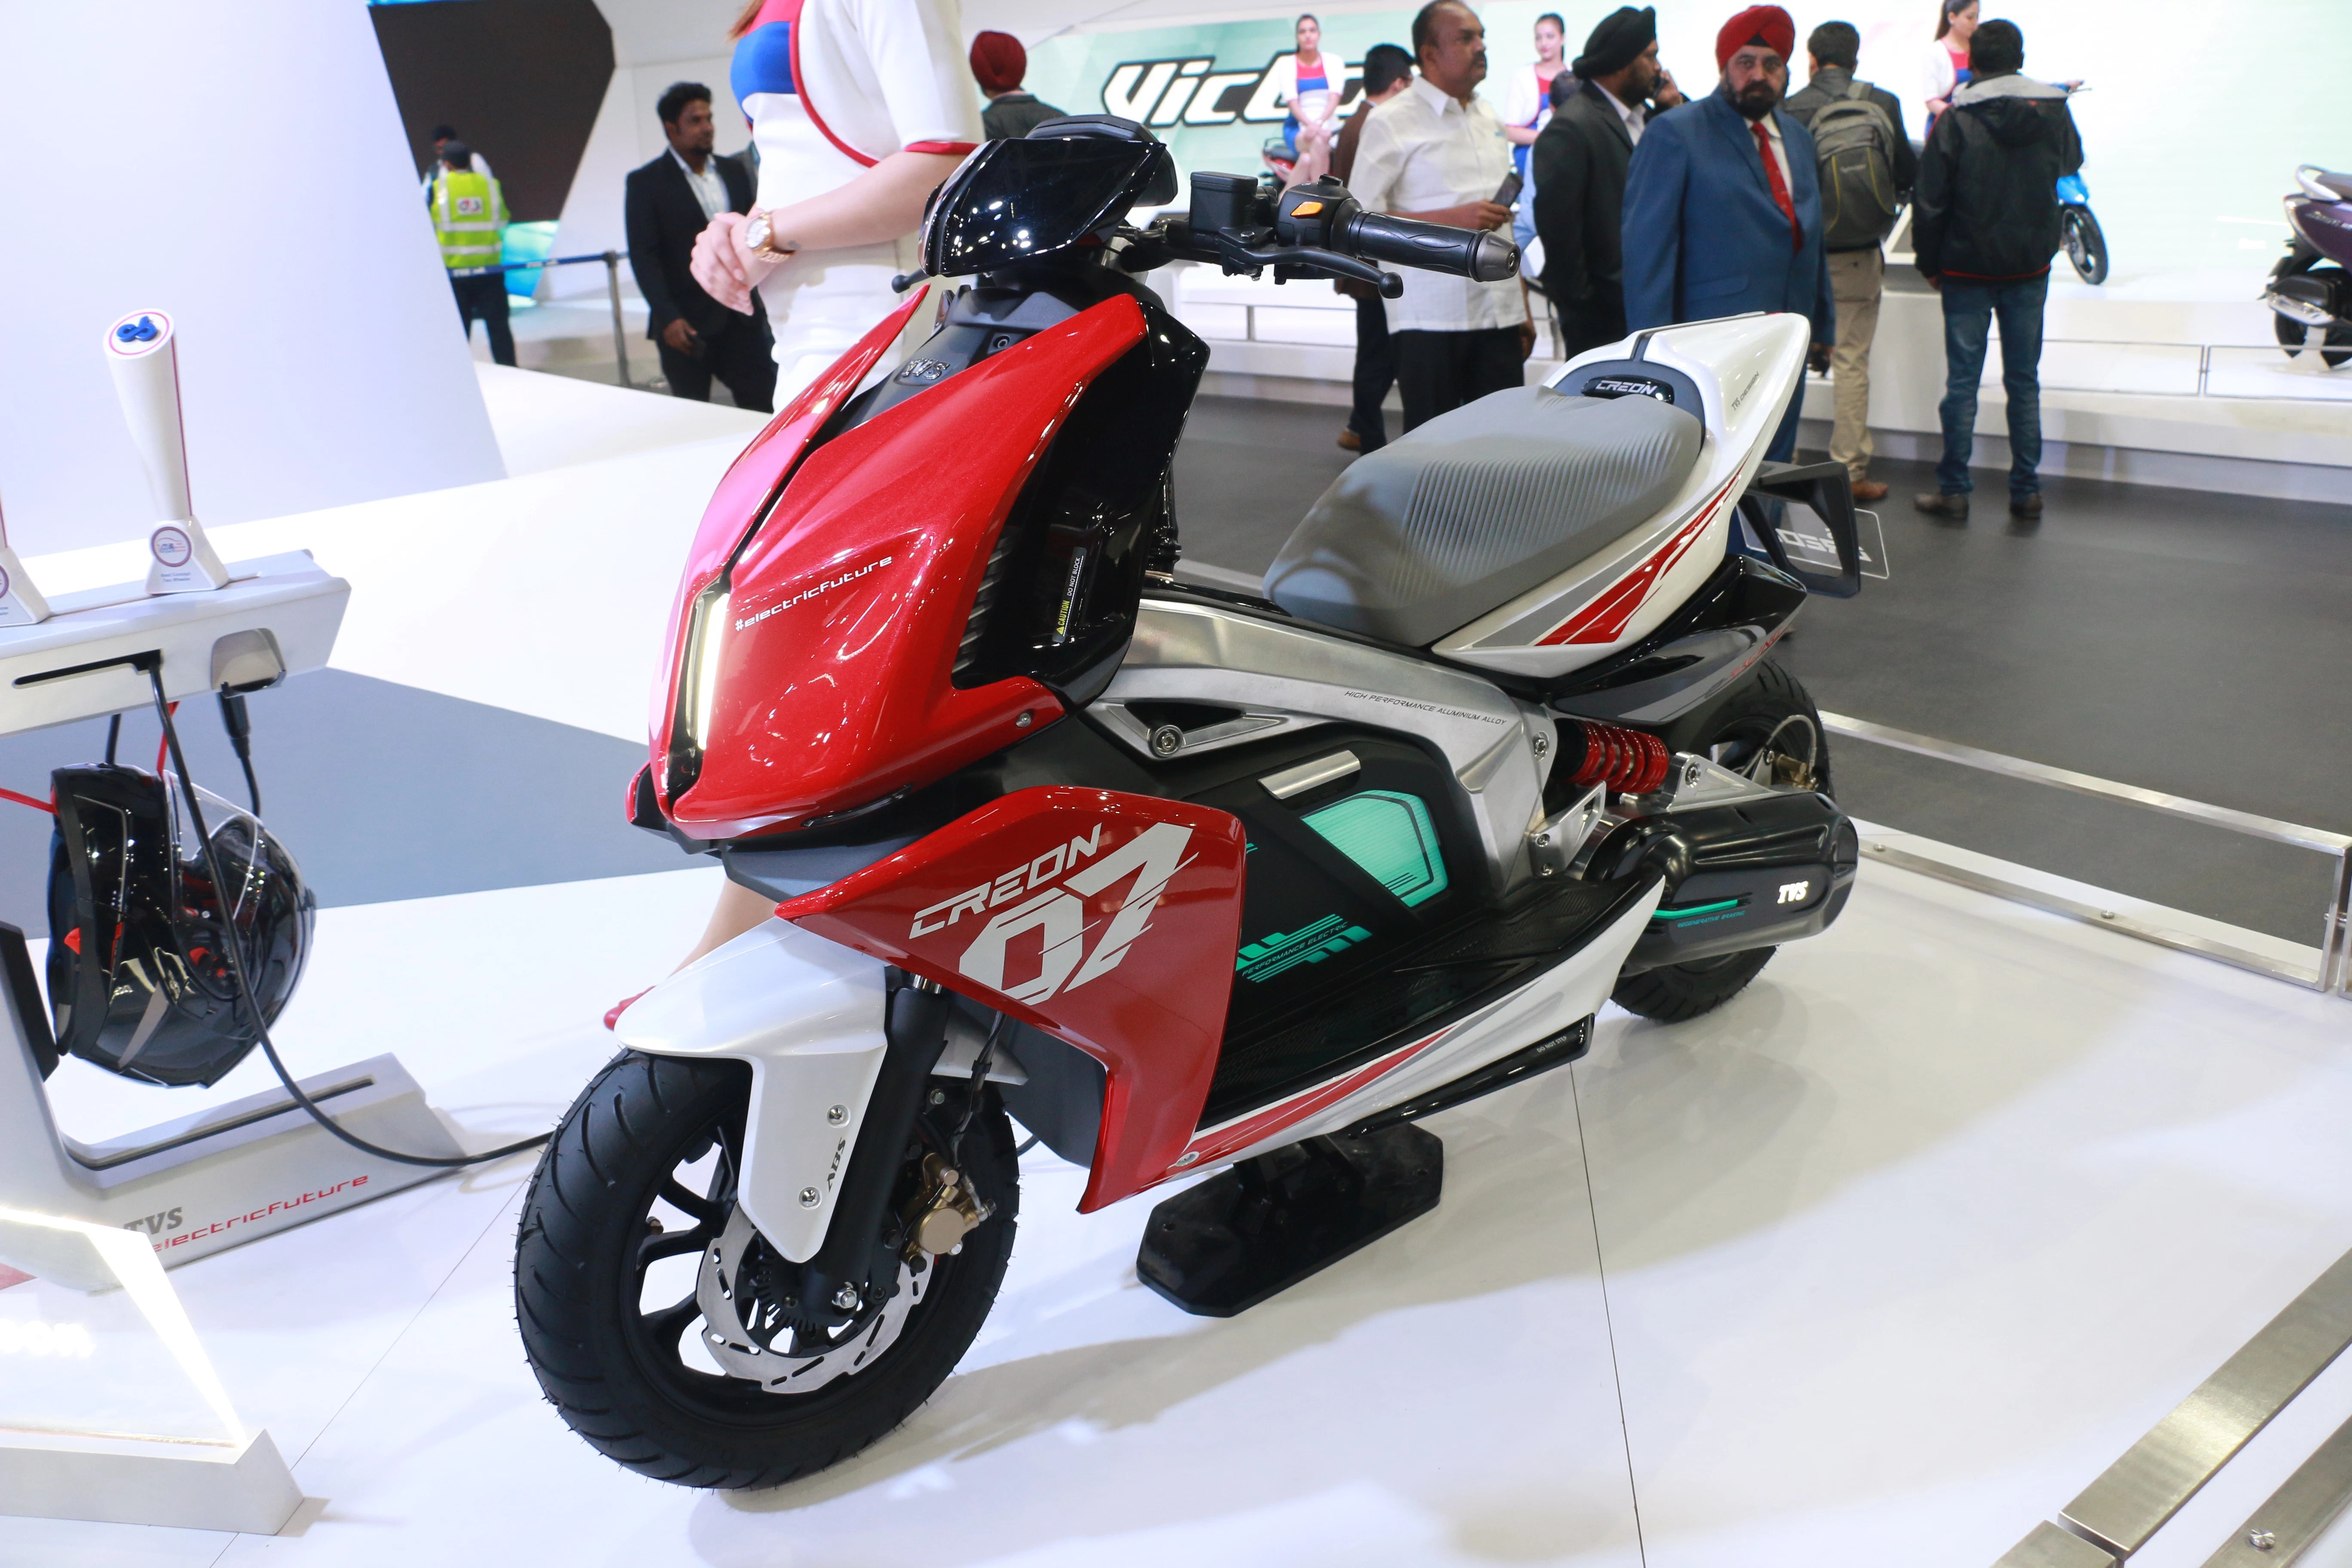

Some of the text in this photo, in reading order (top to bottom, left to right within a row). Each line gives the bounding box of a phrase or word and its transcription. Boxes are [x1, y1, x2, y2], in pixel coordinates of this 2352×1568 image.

[901, 358, 950, 380] TVS
[1595, 380, 1657, 395] CREON
[1740, 371, 1760, 401] DESIGN
[1058, 600, 1070, 626] CAUTION
[1067, 587, 1073, 596] DO
[1072, 557, 1081, 575] BLOCK
[1344, 691, 1507, 725] HIGH PERFORMANCE ALUMINIUM ALLOY
[909, 822, 1102, 939] CREON
[1776, 881, 1809, 904] TVS
[959, 822, 1199, 1006] 07
[1677, 910, 1746, 928] REGENERATIVE BRAKING
[1242, 922, 1348, 977] PERFORMANCE ELECTRIC
[1545, 1041, 1556, 1049] NOT
[1555, 1035, 1567, 1044] STEP
[827, 1136, 845, 1194] ABS
